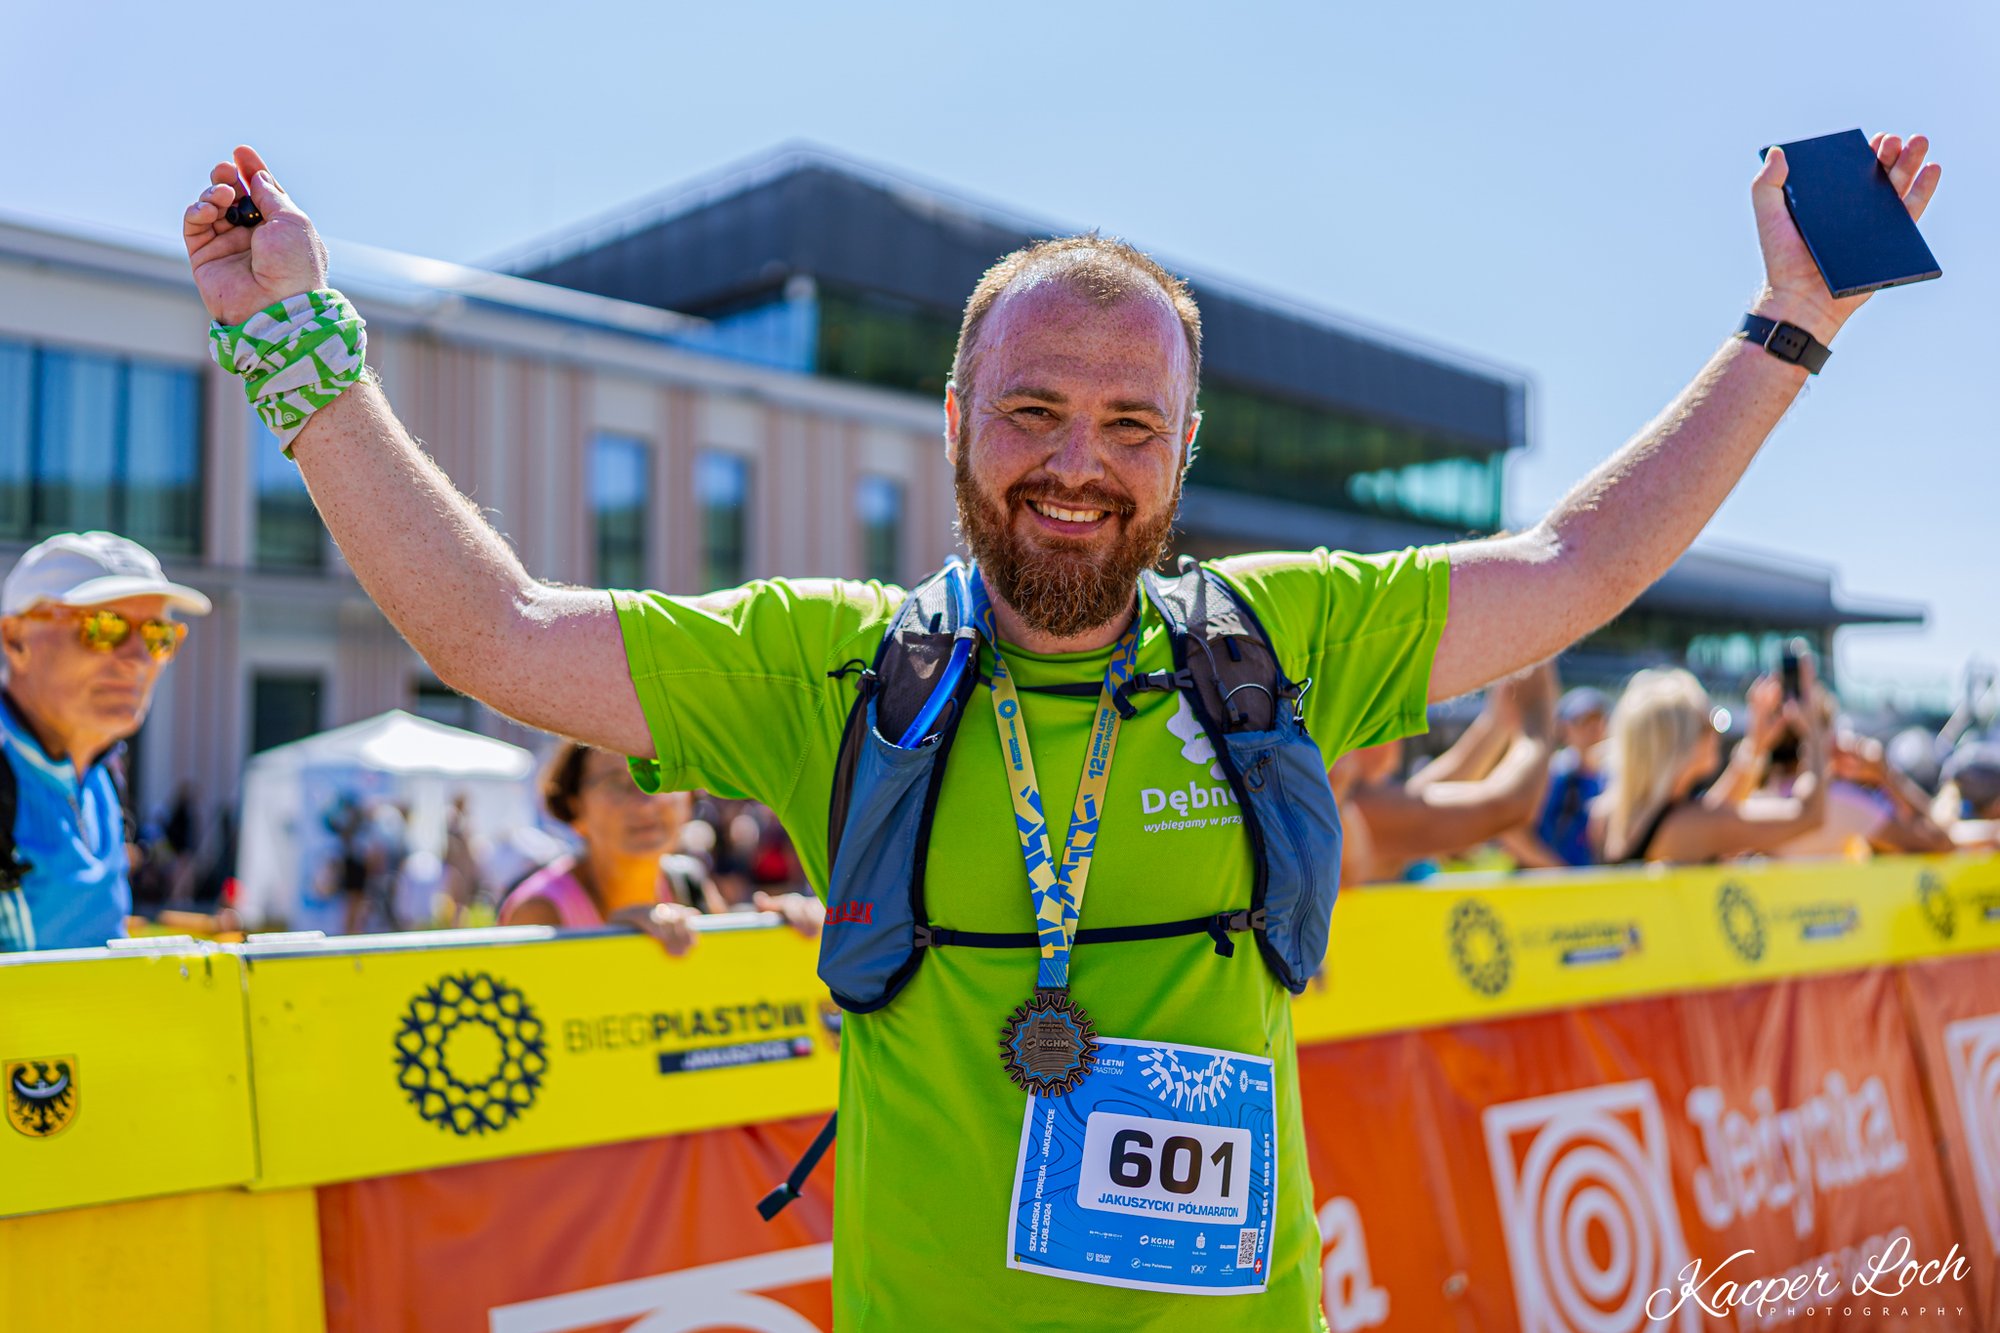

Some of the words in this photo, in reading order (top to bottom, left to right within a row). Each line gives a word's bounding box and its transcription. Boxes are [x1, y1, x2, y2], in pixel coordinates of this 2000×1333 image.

[1088, 757, 1106, 779] 12
[1144, 819, 1208, 833] wybiegamy
[1210, 816, 1219, 825] w
[1221, 815, 1242, 826] przy
[1039, 1038, 1069, 1048] KGHM
[1102, 1058, 1124, 1067] LETNI
[1109, 1129, 1234, 1198] 601
[1029, 1201, 1041, 1252] SZKLARSKA
[1035, 1164, 1047, 1199] PORĘBA
[1042, 1108, 1055, 1158] JAKUSZYCE
[1098, 1193, 1174, 1212] JAKUSZYCKI
[1178, 1202, 1239, 1218] PÓŁMARATON
[1040, 1203, 1053, 1253] 24.08.2024
[1257, 1220, 1267, 1253] 0048
[1150, 1237, 1175, 1246] KGHM
